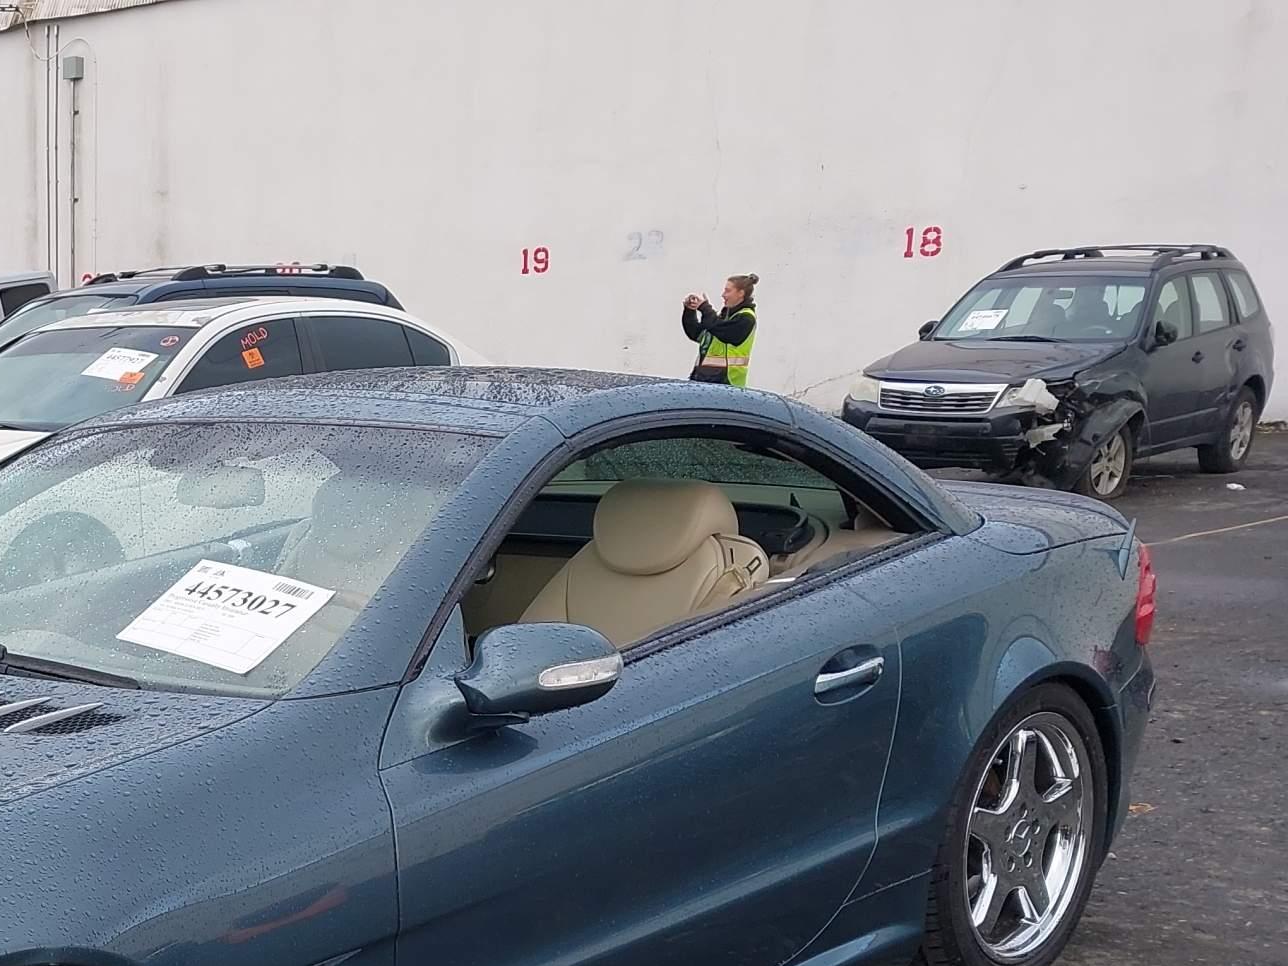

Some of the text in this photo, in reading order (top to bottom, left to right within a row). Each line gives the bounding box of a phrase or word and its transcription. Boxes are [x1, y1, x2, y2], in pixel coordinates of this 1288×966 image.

[903, 226, 942, 258] 18
[520, 246, 550, 275] 19
[240, 327, 268, 350] MOLD
[184, 580, 297, 619] 44573027
